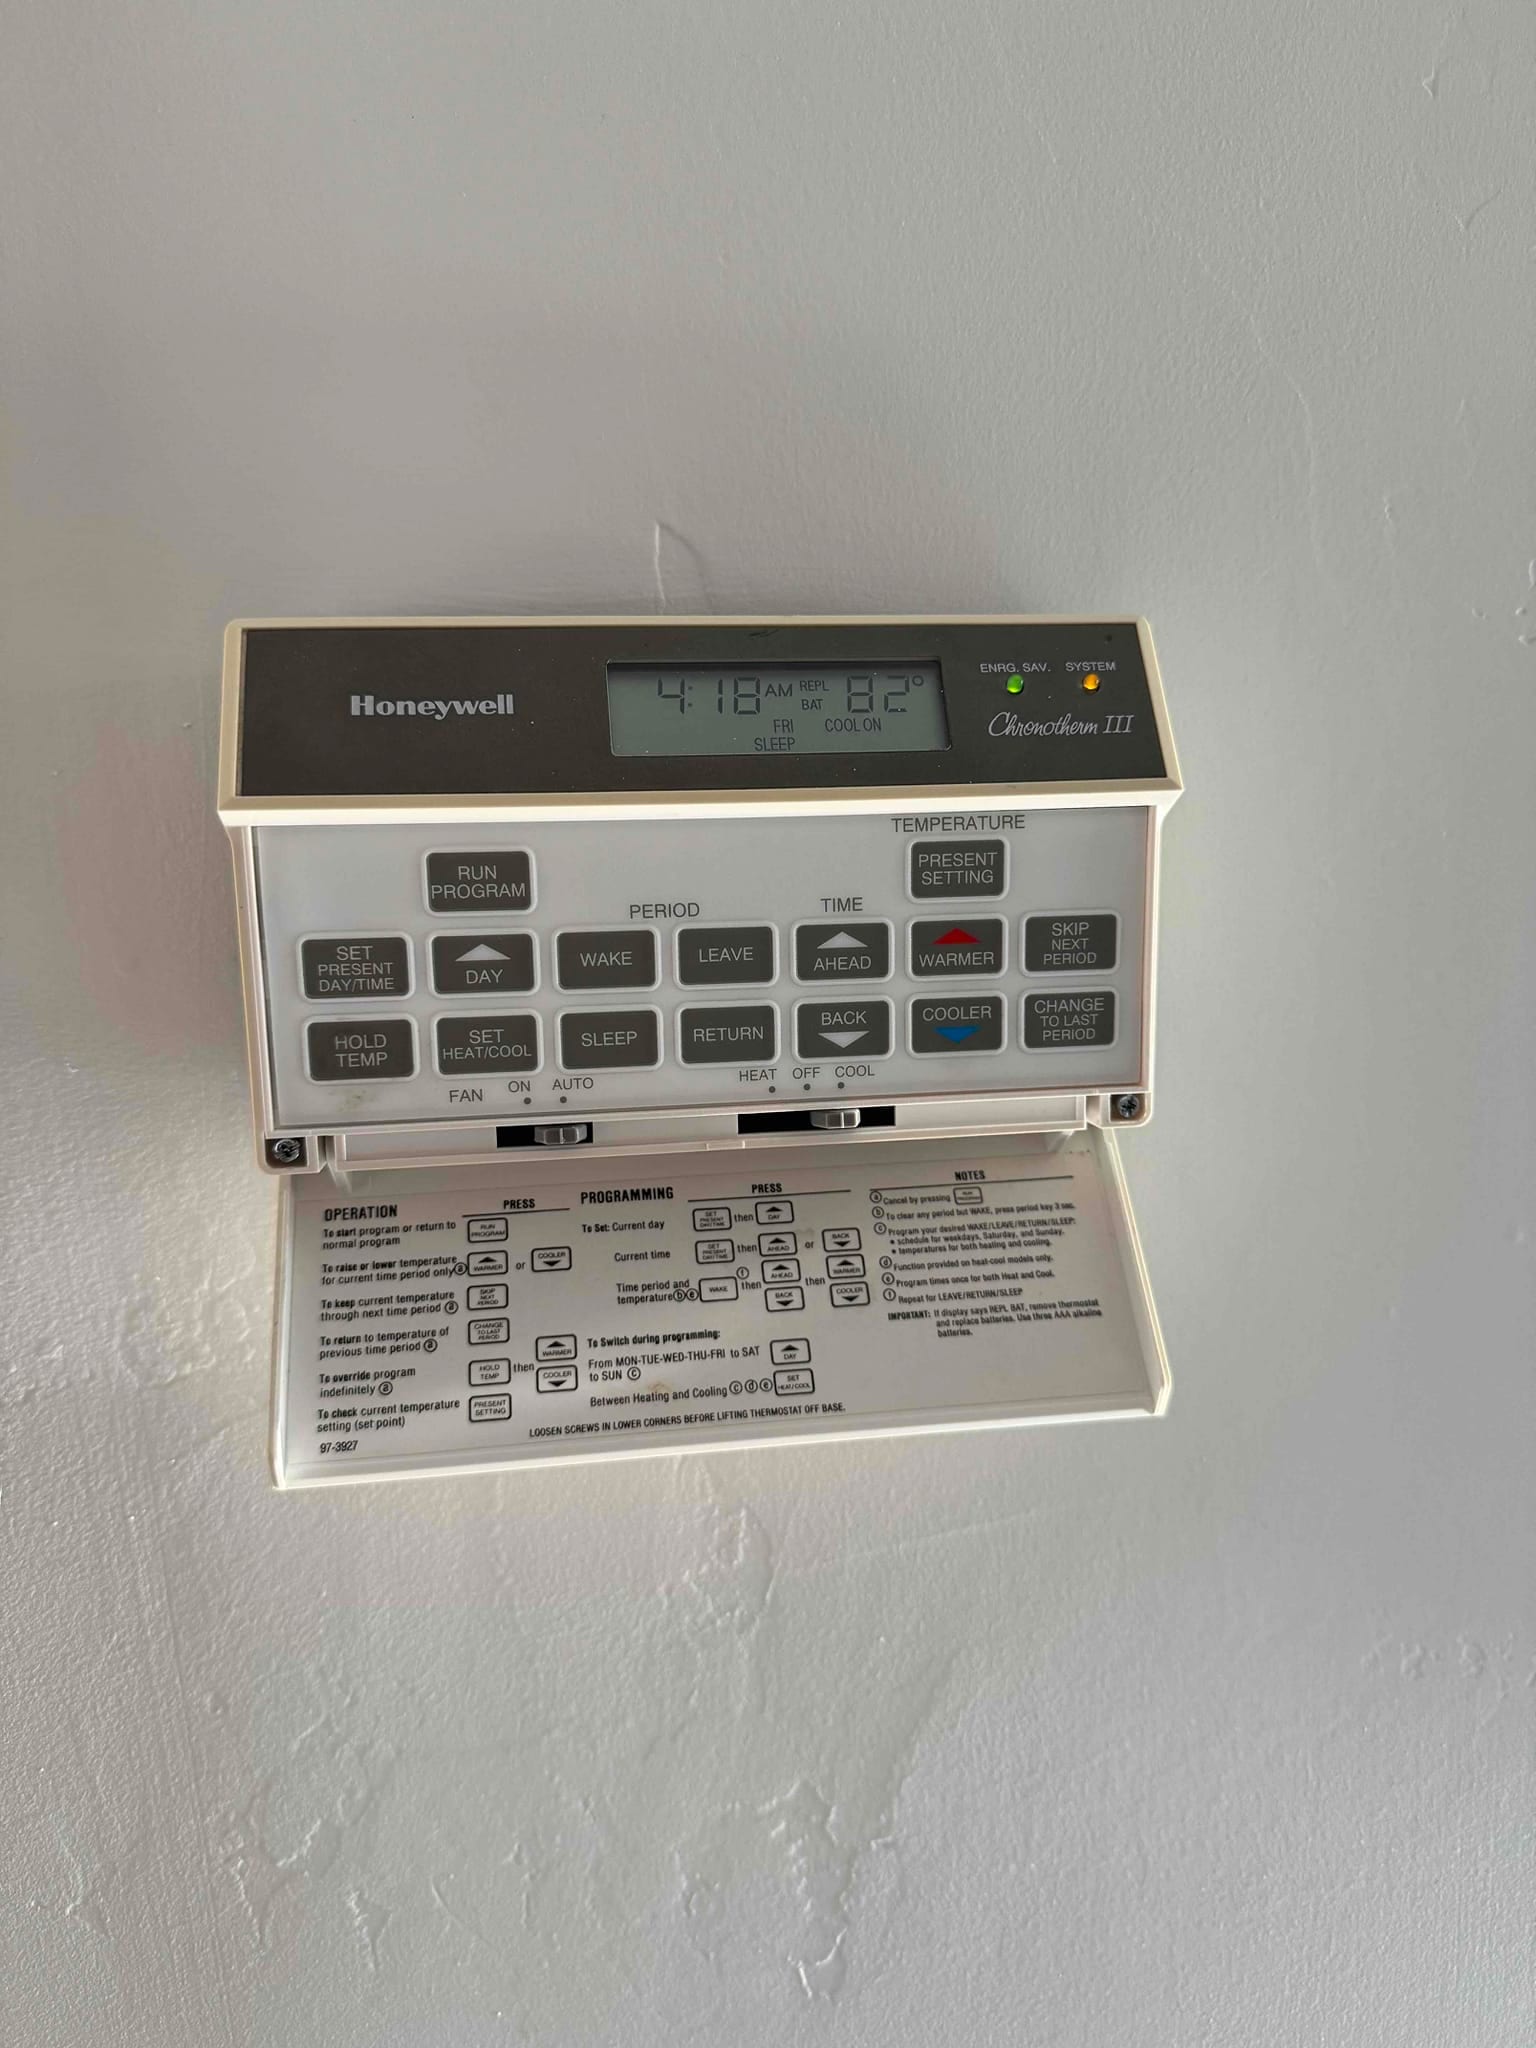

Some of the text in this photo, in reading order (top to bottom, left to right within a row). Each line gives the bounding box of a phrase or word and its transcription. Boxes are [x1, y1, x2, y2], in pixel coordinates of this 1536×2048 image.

[980, 663, 1051, 673] ENRG. SAV.
[1065, 662, 1116, 671] SYSTEM
[799, 680, 829, 692] REPL
[657, 676, 793, 715] 4:18 AM
[350, 694, 514, 720] Honeywell
[801, 699, 823, 710] BAT
[773, 720, 794, 733] FRI
[863, 718, 881, 732] ON
[988, 712, 1134, 737] Chronotherm III
[754, 738, 795, 751] SLEEP
[891, 815, 1025, 832] TEMPERATURE
[918, 852, 997, 868] PRESENT
[458, 866, 497, 881] RUN
[921, 869, 993, 886] SETTING
[431, 883, 526, 899] PROGRAM
[629, 902, 700, 919] PERIOD
[820, 897, 863, 913] TIME
[1051, 922, 1089, 937] SKIP
[1051, 938, 1089, 951] NEXT
[336, 946, 373, 960] SET
[579, 951, 632, 967] WAKE
[699, 947, 753, 963] LEAVE
[919, 951, 995, 968] WARMER
[1043, 952, 1097, 965] PERIOD
[318, 962, 392, 977] PRESENT
[813, 954, 872, 971] AHEAD
[466, 969, 503, 984] DAY
[319, 978, 394, 992] DAY/TIME
[922, 1005, 992, 1022] COOLER
[1034, 998, 1105, 1014] CHANGE
[821, 1010, 866, 1026] BACK
[1040, 1013, 1098, 1027] TO LAST
[469, 1029, 504, 1044] SET
[581, 1031, 638, 1047] SLEEP
[694, 1026, 764, 1043] RETURN
[1043, 1027, 1095, 1041] PERIOD
[334, 1034, 387, 1050] HOLD
[336, 1053, 388, 1068] TEMP
[443, 1045, 532, 1061] HEAT/COOL
[739, 1064, 875, 1082] HEAT OFF COOL
[449, 1077, 594, 1103] FAN ON AUTO
[955, 1170, 985, 1181] NOTES
[581, 1187, 674, 1205] PROGRAMMING
[752, 1183, 782, 1194] PRESS
[503, 1199, 535, 1209] PRESS
[324, 1204, 398, 1222] OPERATION
[734, 1213, 754, 1222] then
[324, 1221, 456, 1238] To start program or return to
[582, 1220, 664, 1233] To Set: Current day
[322, 1236, 400, 1250] normal program
[737, 1243, 757, 1253] then
[805, 1240, 815, 1249] or
[615, 1250, 670, 1262] Current time
[322, 1255, 457, 1273] To raise or lower temperature
[516, 1260, 525, 1271] or
[322, 1267, 454, 1285] for current time period only
[805, 1276, 825, 1286] then
[617, 1280, 690, 1293] Time period and
[741, 1280, 762, 1290] then
[321, 1290, 454, 1309] To keep current temperature
[617, 1292, 673, 1305] temperature
[899, 1295, 924, 1304] Repeat
[926, 1293, 936, 1302] for
[321, 1303, 441, 1321] through next time period
[888, 1310, 931, 1321] IMPORTANT:
[320, 1326, 449, 1346] To return to temperature of
[587, 1330, 721, 1348] To Switch during programming:
[319, 1341, 421, 1360] previous time period
[588, 1346, 760, 1370] From MON-TUE-WED-THU-FRI to SAT
[513, 1362, 535, 1373] then
[320, 1368, 416, 1383] To override program
[590, 1370, 622, 1382] to SUN
[320, 1384, 376, 1398] indefinitely
[590, 1385, 728, 1408] Between Heating and Cooling
[318, 1400, 460, 1419] To check current temperature
[317, 1416, 405, 1433] setting (set point)
[529, 1402, 846, 1438] LOOSEN SCREWS IN LOWER CORNERS BEFORE LIFTING THERMOSTAT OFF BASE.
[320, 1440, 358, 1453] 97-3927
